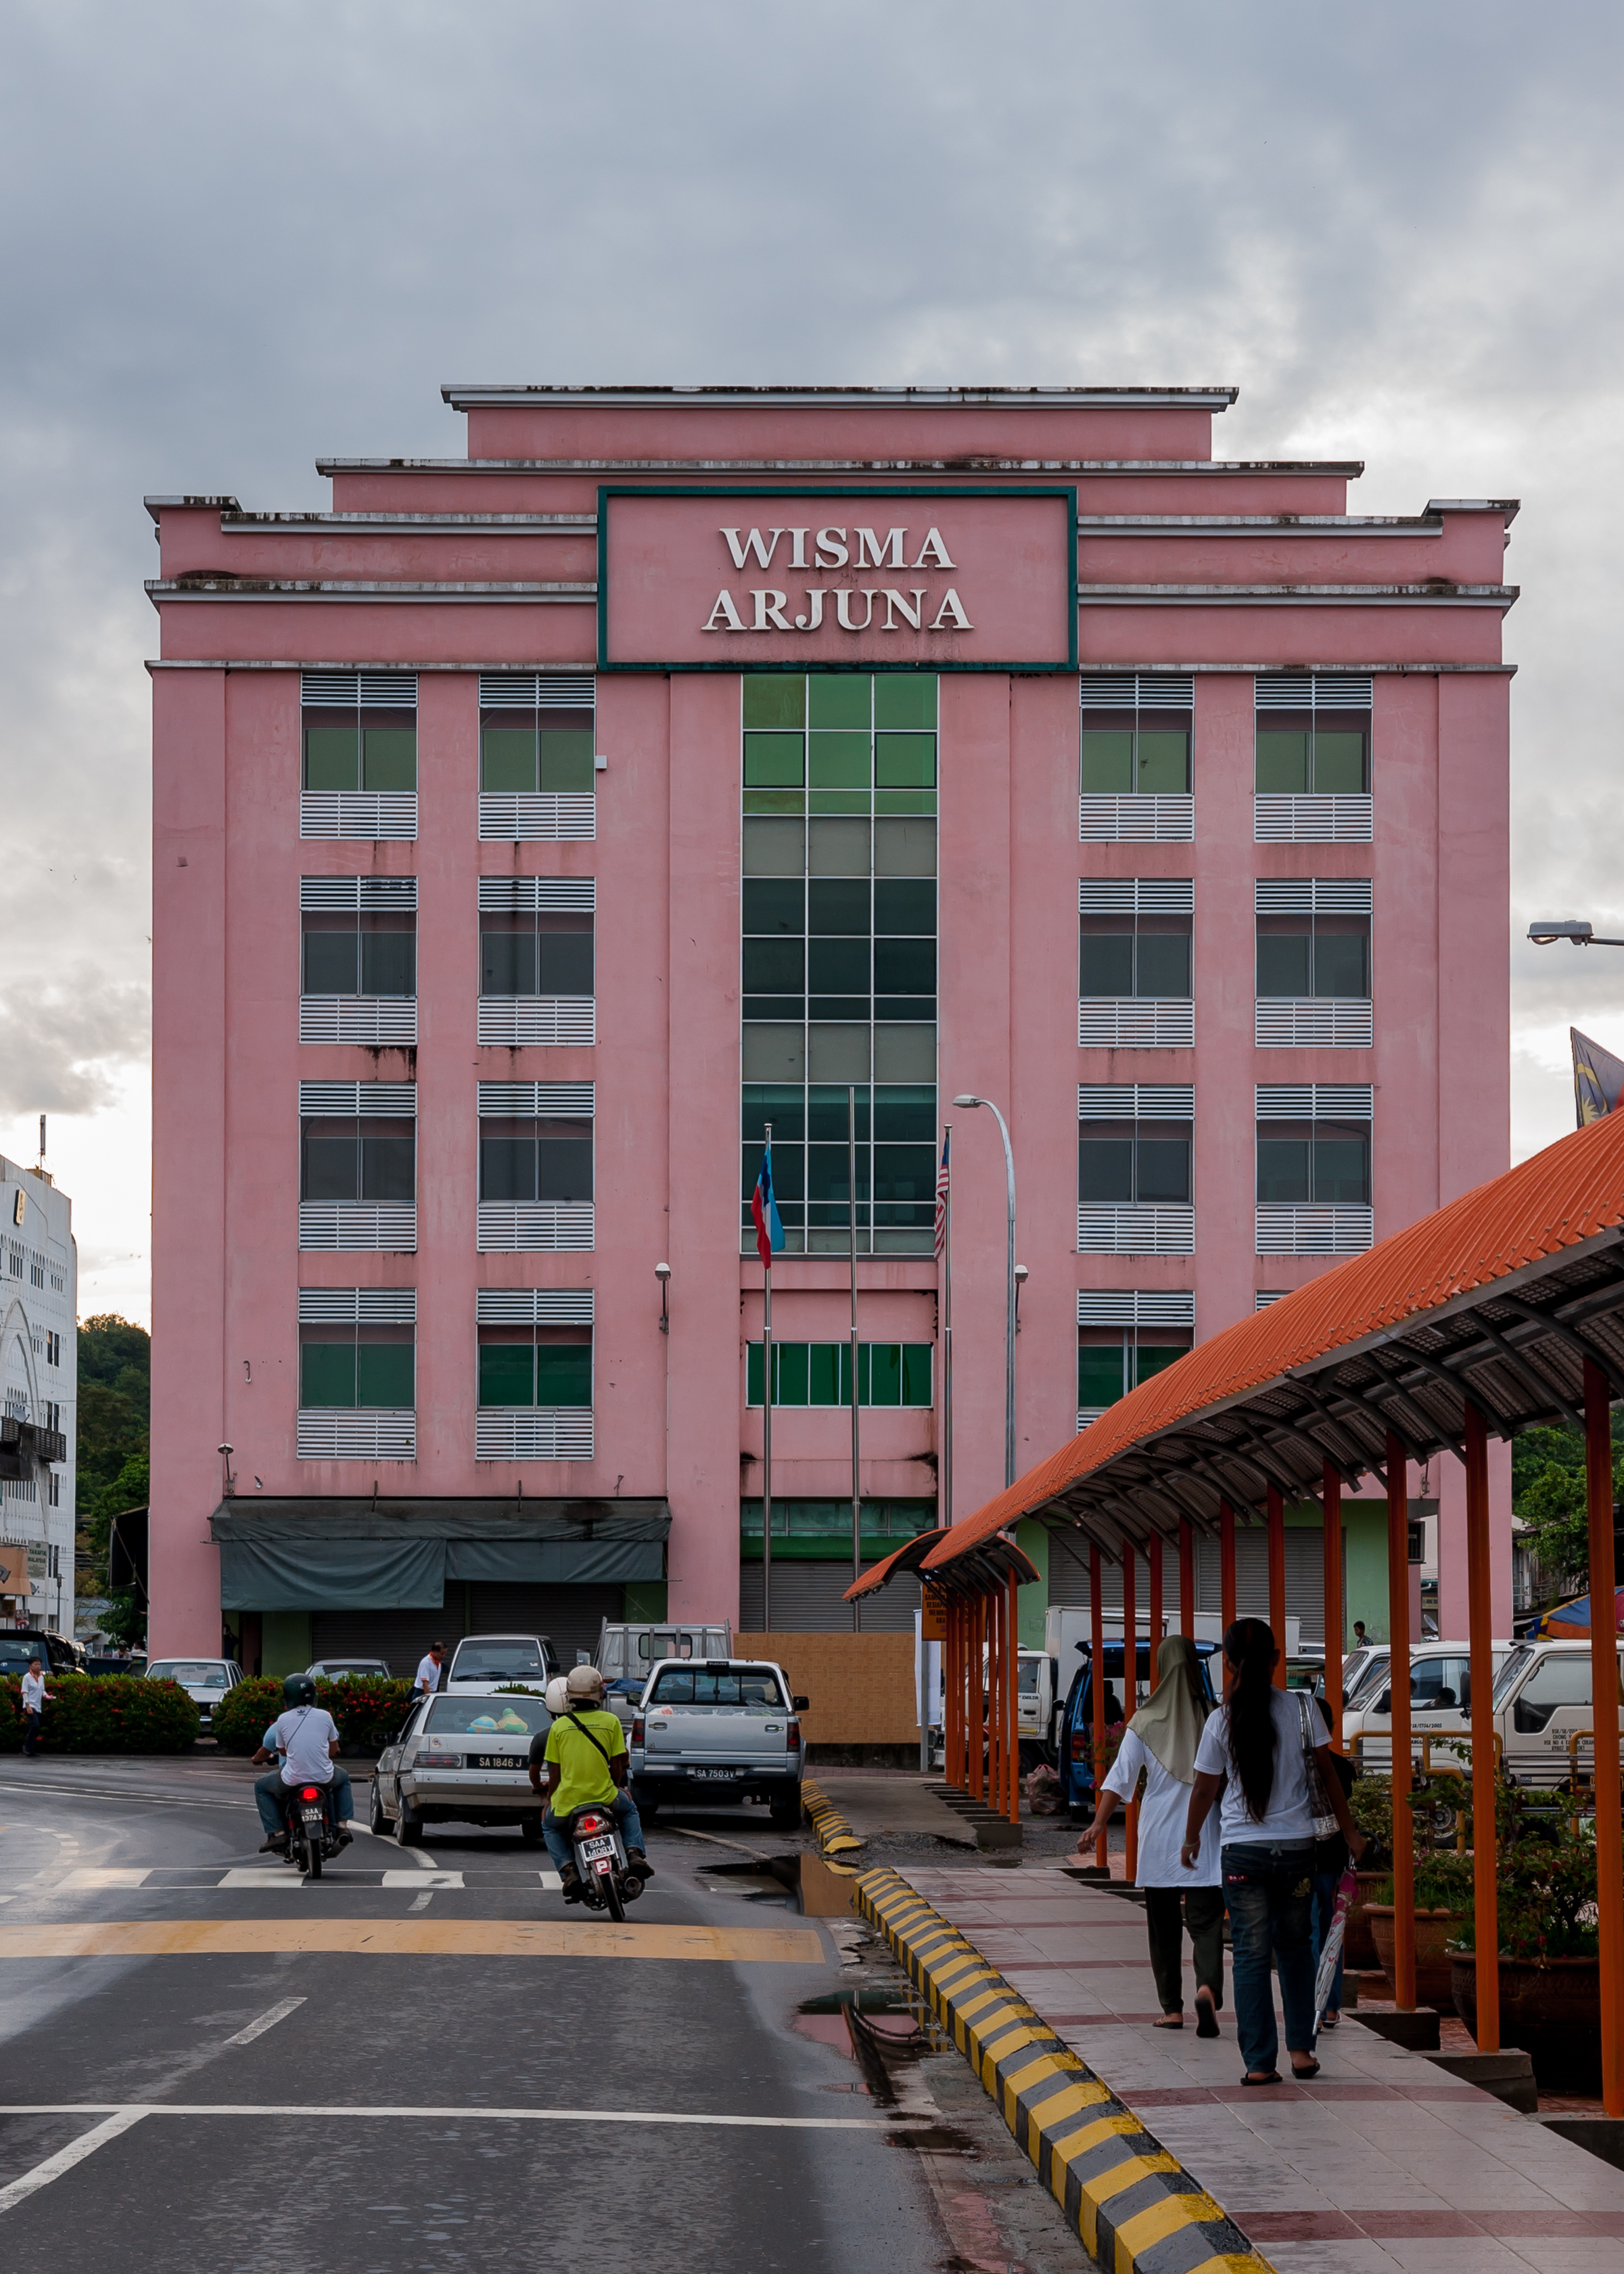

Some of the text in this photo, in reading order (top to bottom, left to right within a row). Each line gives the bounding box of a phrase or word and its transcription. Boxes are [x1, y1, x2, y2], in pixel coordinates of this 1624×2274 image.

[719, 526, 958, 569] WISMA
[701, 588, 975, 631] ARJUNA
[479, 1757, 522, 1767] SA 1846 J
[697, 1769, 706, 1777] SA
[589, 1839, 605, 1849] SAA
[588, 1845, 611, 1857] 1408Y
[596, 1860, 608, 1873] P
